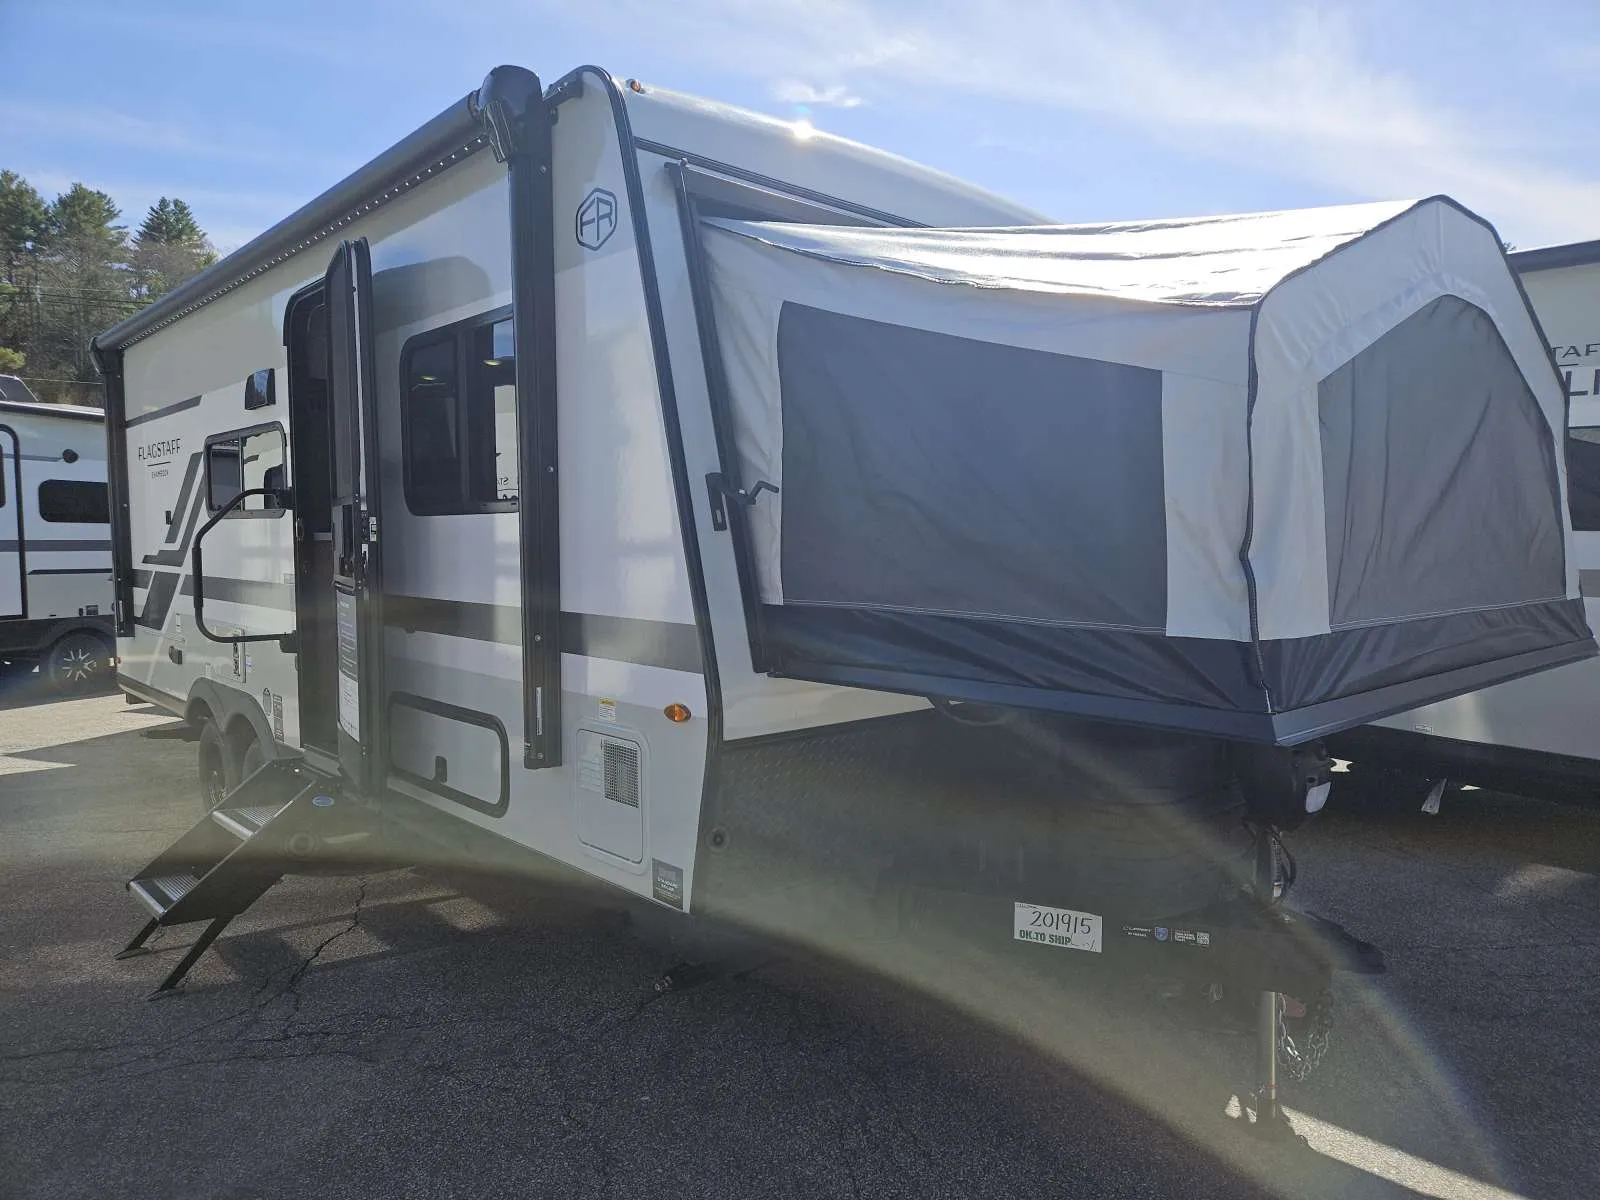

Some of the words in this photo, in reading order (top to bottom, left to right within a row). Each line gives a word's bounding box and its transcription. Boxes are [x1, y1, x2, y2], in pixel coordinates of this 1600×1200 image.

[138, 438, 181, 461] FLAGSTAFF
[1030, 910, 1092, 935] 201915
[1048, 933, 1072, 946] SHIP
